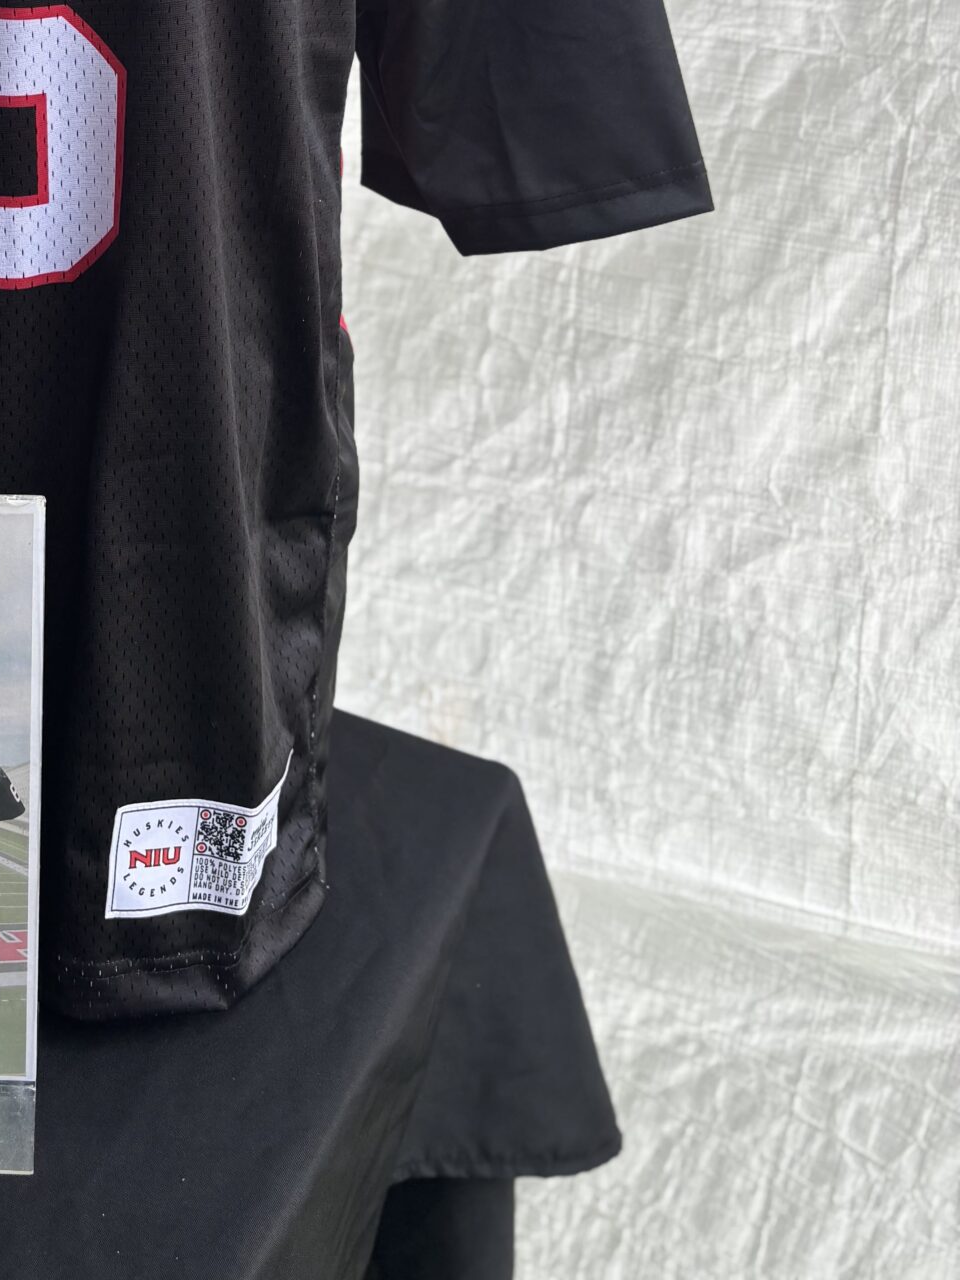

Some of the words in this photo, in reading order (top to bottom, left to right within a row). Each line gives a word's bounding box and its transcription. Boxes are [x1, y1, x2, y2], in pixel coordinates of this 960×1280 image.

[123, 819, 190, 848] HUSKIES
[129, 846, 182, 869] NIU
[196, 858, 215, 868] 100%
[195, 865, 208, 874] USE
[211, 867, 229, 878] MILD
[123, 866, 185, 897] LEGENDS
[193, 880, 212, 890] HANG
[207, 874, 220, 883] NOT
[222, 878, 237, 888] USE
[192, 892, 212, 902] MADE
[214, 895, 223, 903] IN
[225, 897, 238, 907] THE
